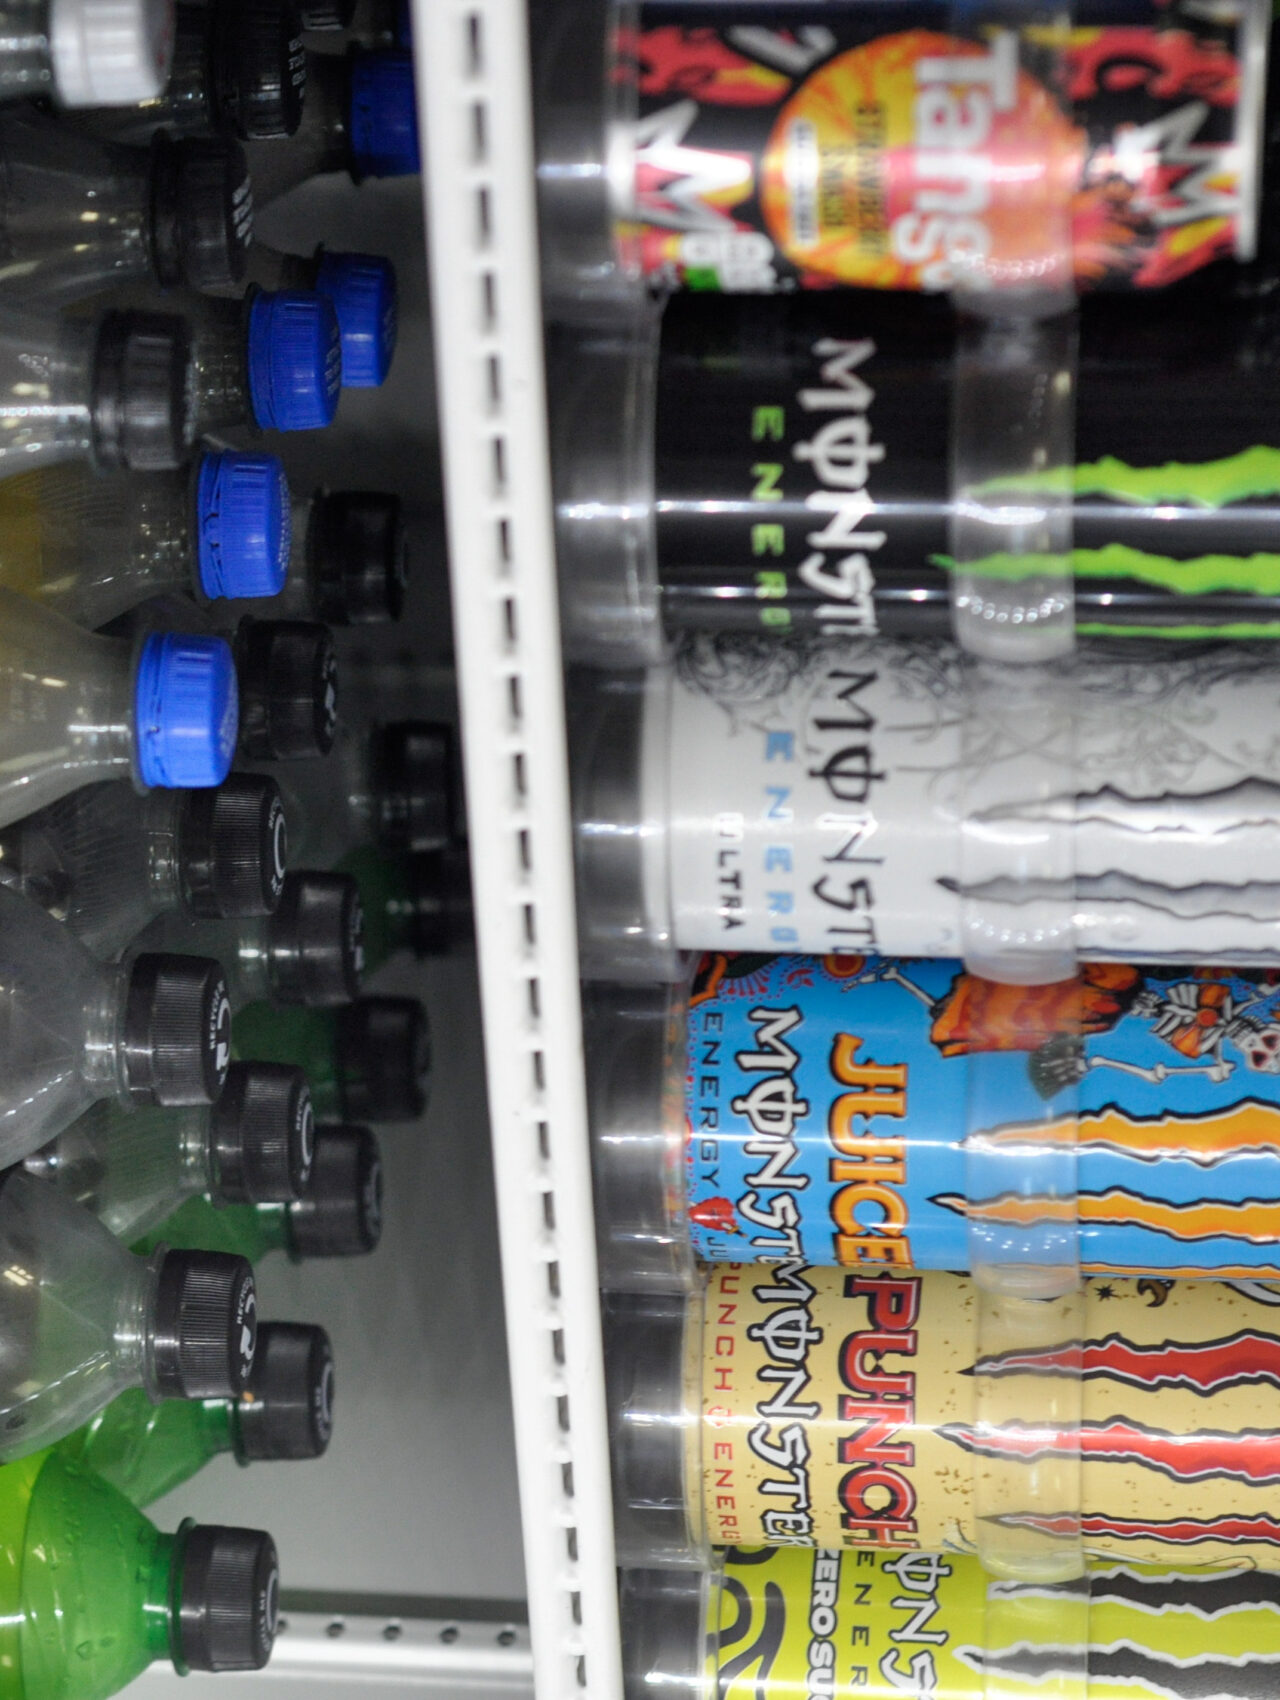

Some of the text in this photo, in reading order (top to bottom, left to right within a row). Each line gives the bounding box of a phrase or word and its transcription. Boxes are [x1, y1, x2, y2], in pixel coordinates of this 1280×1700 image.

[794, 337, 886, 635] MONST
[699, 1011, 724, 1189] ENERGY
[714, 1442, 742, 1543] ENERG
[836, 1273, 921, 1550] PUNCH
[808, 1549, 842, 1635] ZERO
